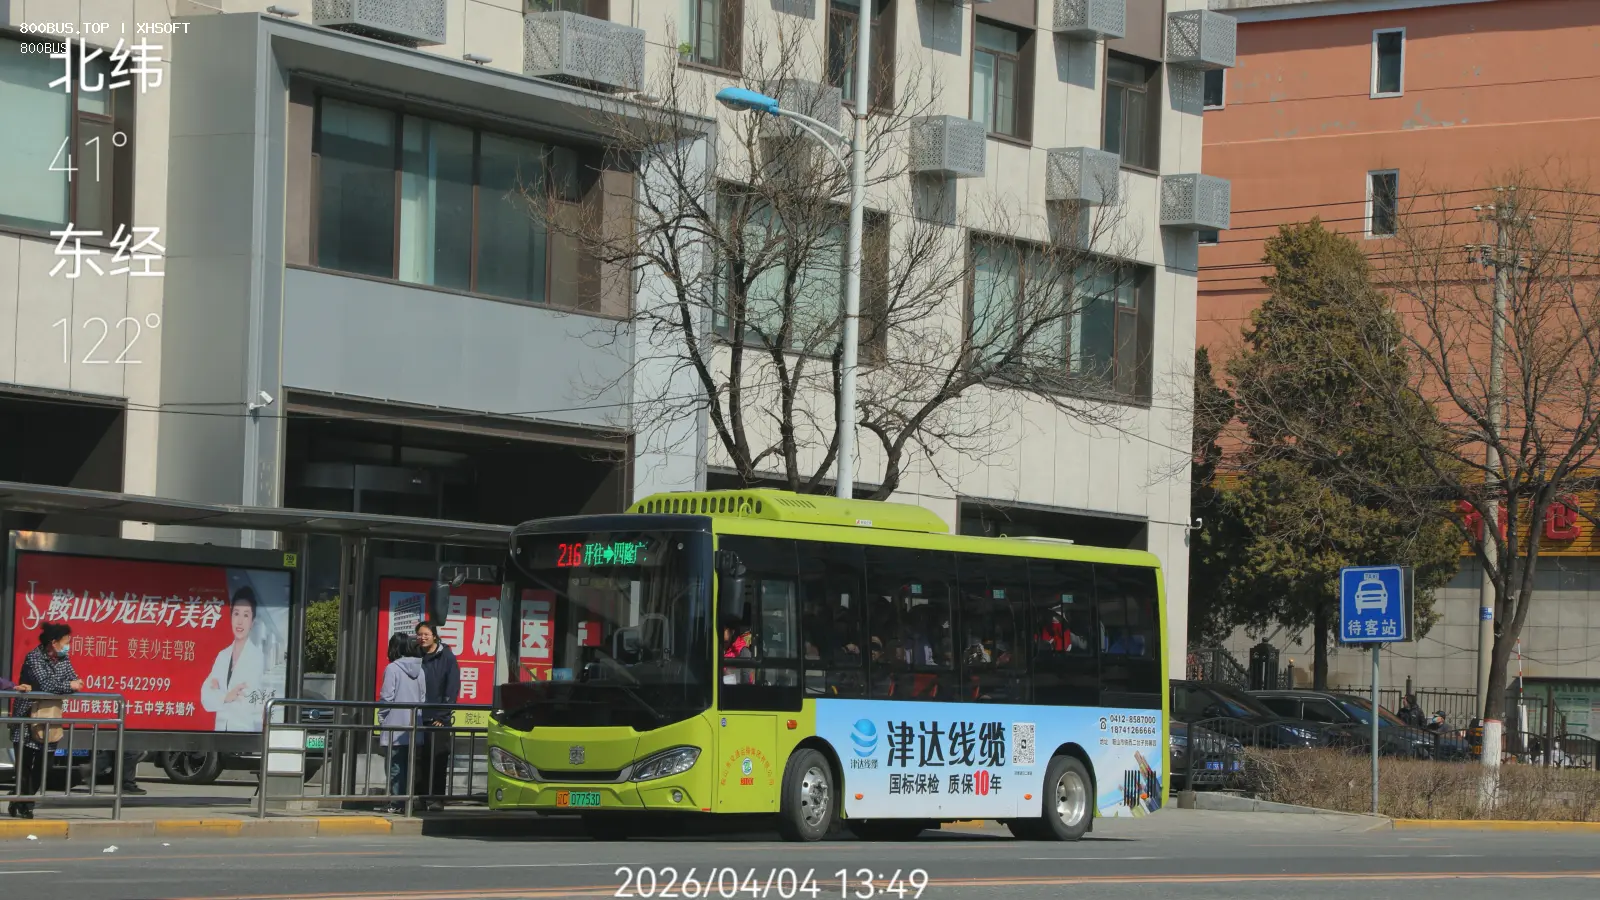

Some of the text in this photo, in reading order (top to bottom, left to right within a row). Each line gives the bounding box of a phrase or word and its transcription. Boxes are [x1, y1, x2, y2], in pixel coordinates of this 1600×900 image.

[557, 543, 582, 567] 216
[47, 588, 224, 629] 鞍山沙龙医疗美容
[1348, 619, 1396, 636] 待客站
[68, 634, 195, 661] 向美而生 变美少走弯路
[86, 674, 171, 691] 0412-5422999
[887, 721, 1006, 767] 津达线缆
[850, 758, 878, 769] 津达线缆
[889, 769, 1002, 796] 国标保检 质保10年
